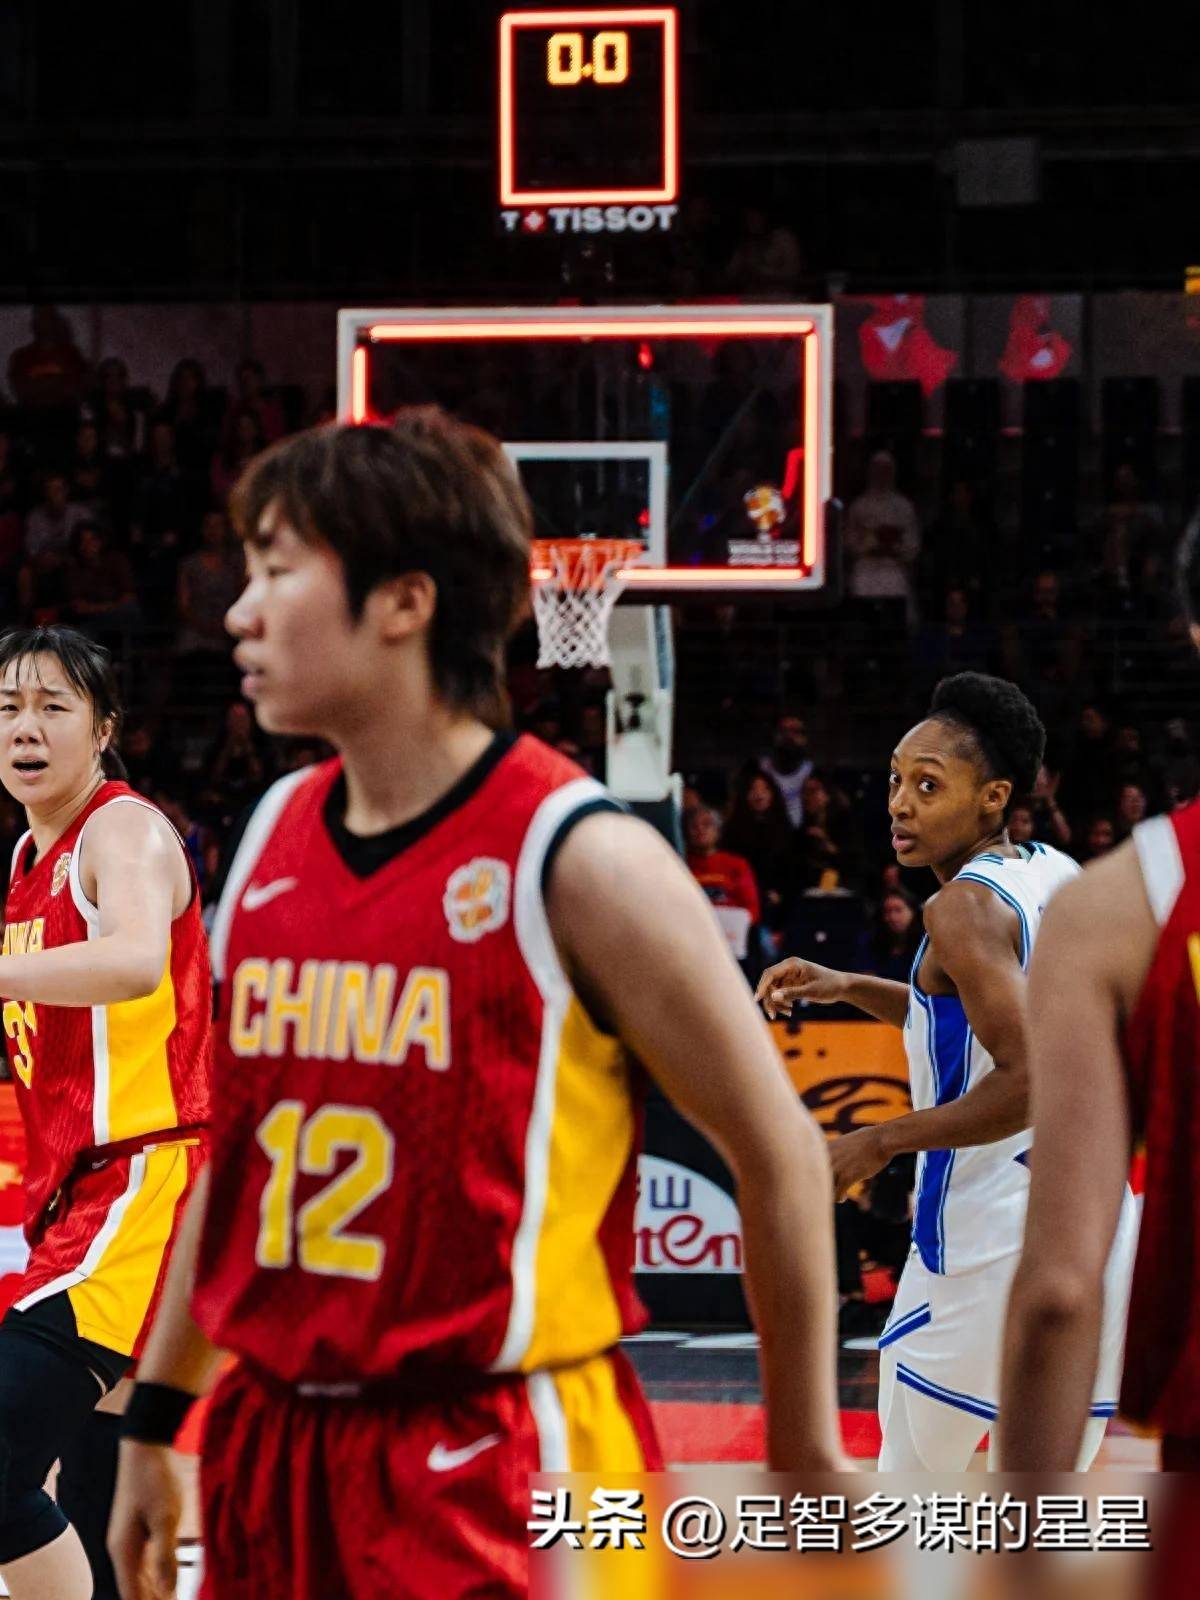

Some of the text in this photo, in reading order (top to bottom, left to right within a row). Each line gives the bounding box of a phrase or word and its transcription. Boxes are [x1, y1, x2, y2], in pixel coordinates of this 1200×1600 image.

[546, 31, 629, 86] 0.0
[548, 205, 678, 233] TISSOT
[229, 957, 452, 1072] CHINA
[255, 1099, 396, 1282] 12
